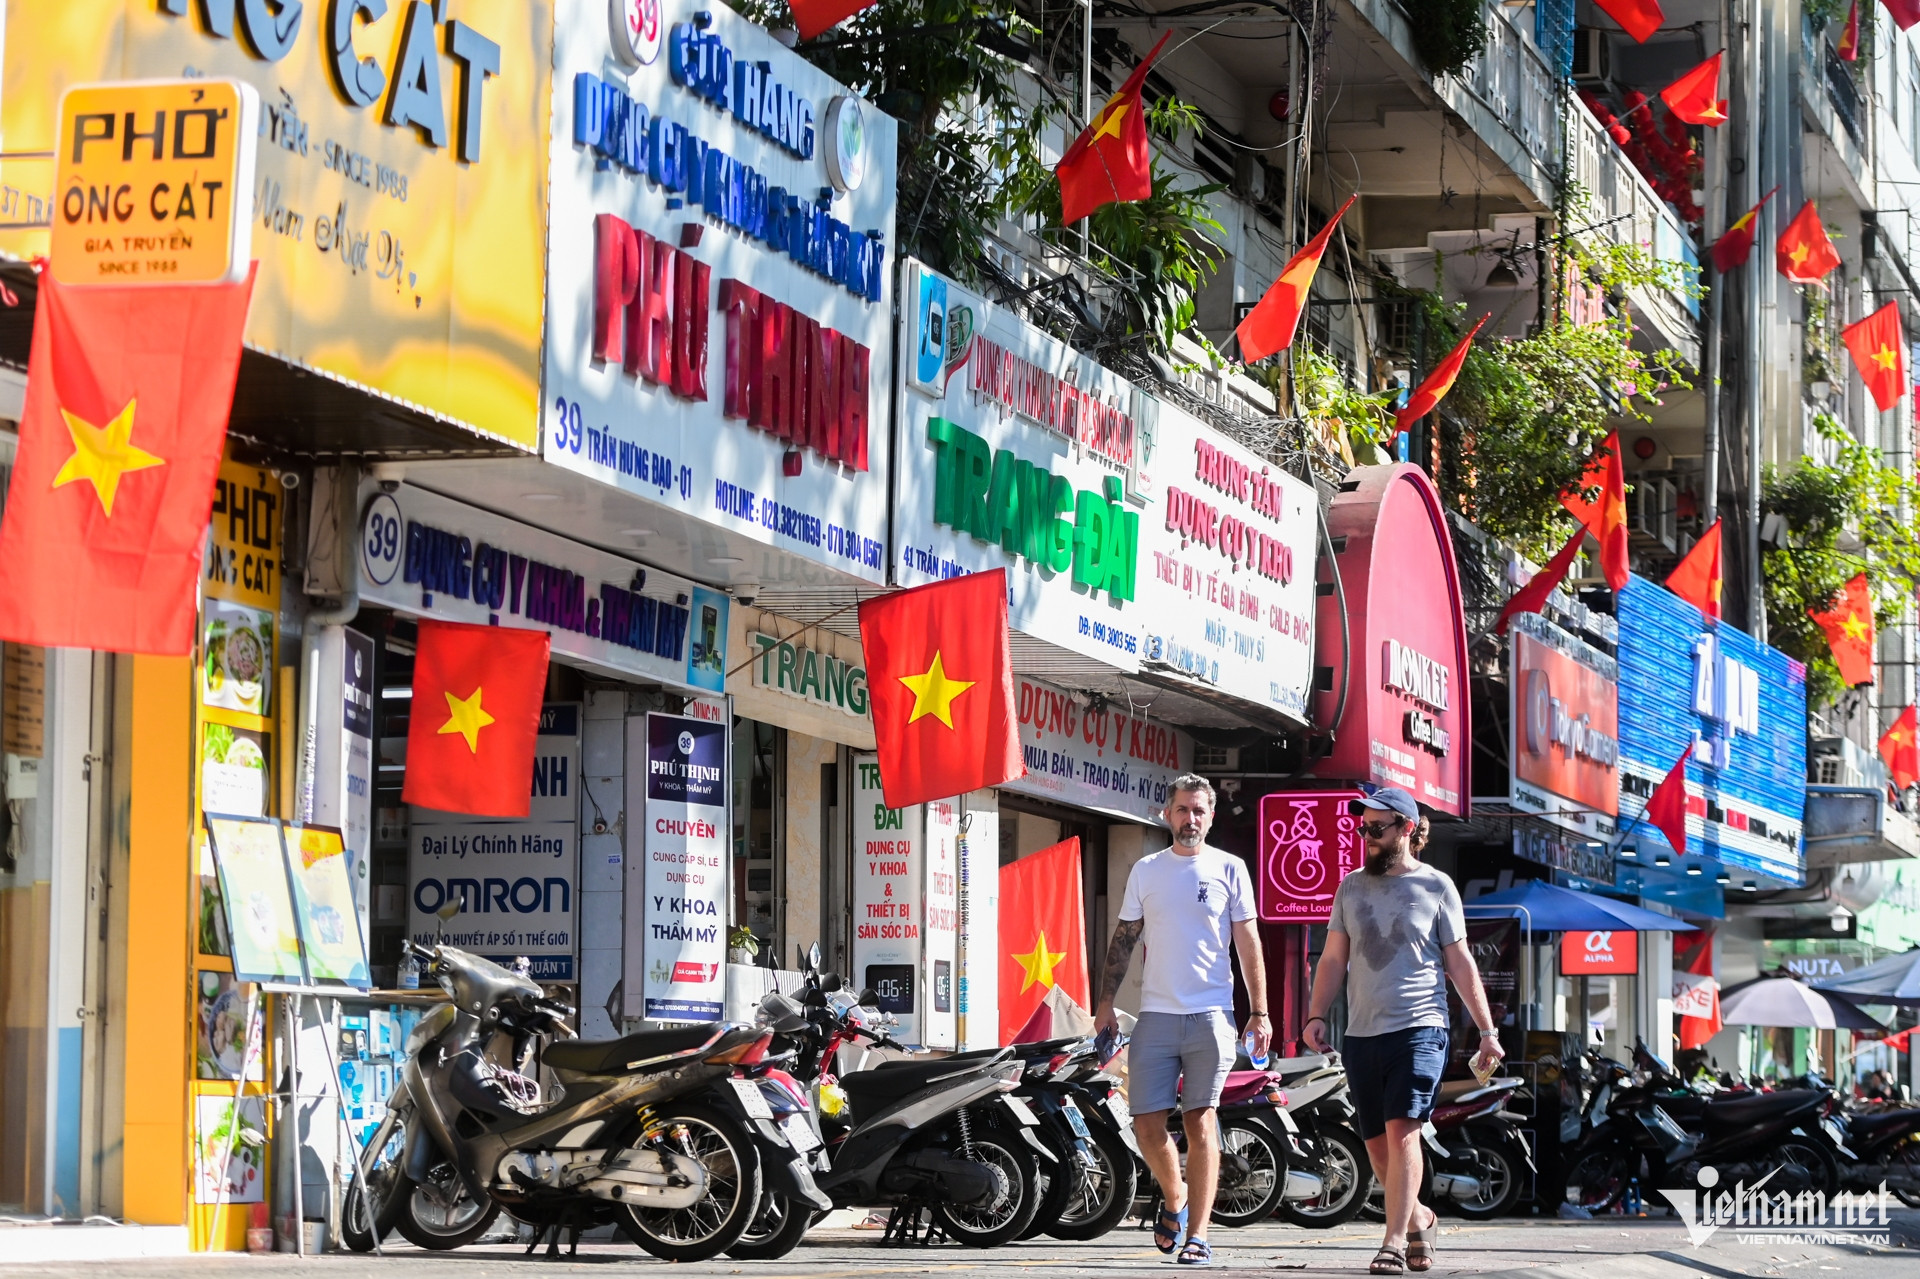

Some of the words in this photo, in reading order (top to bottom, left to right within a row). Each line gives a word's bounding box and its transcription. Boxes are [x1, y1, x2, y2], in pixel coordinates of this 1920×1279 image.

[72, 89, 228, 165] PHỞ
[257, 86, 309, 158] YỀN
[324, 138, 371, 188] SINCE
[375, 162, 409, 203] 1988
[63, 174, 135, 225] ÔNG
[150, 169, 223, 222] CÁT
[85, 238, 114, 253] GIA
[123, 227, 193, 253] TRUYỀN
[99, 261, 140, 275] SINCE
[145, 260, 178, 273] 1988
[592, 213, 711, 402] PHÚ
[718, 278, 870, 477] THỊNH
[555, 397, 582, 455] 39
[588, 424, 617, 466] TRẦN
[619, 440, 649, 482] HƯNG
[652, 459, 672, 497] ĐẠO
[680, 466, 692, 501] Q1
[1195, 438, 1249, 505] TRUNG
[1250, 465, 1283, 524] TÂM
[929, 417, 1075, 573] TRANG
[1073, 475, 1139, 603] ĐÀI
[368, 514, 399, 562] 39
[762, 497, 821, 548] 028.38211659
[828, 523, 844, 557] 070
[846, 529, 861, 563] 304
[864, 537, 883, 571] 0567
[1166, 486, 1219, 550] DỤNG
[1219, 513, 1245, 574] CỤ
[1246, 526, 1258, 570] Y
[903, 545, 914, 568] 41
[916, 544, 939, 579] TRẦN
[404, 521, 472, 608] DỤNG
[473, 543, 508, 626] CỤ
[510, 554, 527, 615] Y
[526, 560, 585, 634] KHOA
[586, 598, 601, 638] &
[657, 593, 689, 662] MỸ
[1183, 563, 1193, 600] BỊ
[1196, 569, 1202, 596] Y
[1270, 604, 1290, 636] CHLB
[1093, 621, 1106, 642] 090
[1107, 627, 1123, 649] 3003
[1142, 635, 1163, 660] 43
[747, 631, 867, 717] TRANG
[1019, 682, 1076, 739] DỤNG
[1083, 706, 1109, 757] CỤ
[1114, 713, 1126, 753] Y
[1129, 718, 1179, 770] KHOA
[680, 737, 692, 749] 39
[531, 756, 568, 797] NH
[651, 758, 677, 777] PHÚ
[679, 764, 720, 783] THỊNH
[859, 763, 883, 789] TR
[1024, 745, 1047, 772] MUA
[1051, 749, 1074, 779] BÁN
[1083, 761, 1109, 788] TRAO
[1112, 762, 1129, 794] ĐỔI
[1139, 774, 1152, 800] KÝ
[1154, 775, 1168, 805] GỞ
[659, 781, 664, 789] Y
[664, 782, 681, 791] KHOA
[655, 818, 716, 839] CHUYÊN
[421, 836, 448, 860] Đại
[452, 835, 469, 859] Lý
[472, 835, 517, 854] Chính
[522, 835, 563, 857] Hãng
[653, 851, 677, 863] CUNG
[678, 851, 696, 865] CẤP
[866, 841, 895, 858] DỤNG
[897, 841, 911, 858] CỤ
[667, 872, 690, 884] DỤNG
[692, 873, 705, 885] CỤ
[870, 862, 877, 876] Y
[879, 862, 908, 876] KHOA
[884, 882, 893, 897] &
[654, 896, 664, 911] Y
[670, 897, 717, 916] KHOA
[866, 898, 896, 918] THIẾT
[899, 904, 910, 921] BỊ
[1275, 903, 1308, 913] Coffee
[413, 929, 434, 946] MÁY
[453, 930, 485, 946] HUYẾT
[487, 930, 501, 946] ÁP
[502, 929, 516, 946] SỐ
[518, 933, 523, 945] 1
[526, 929, 547, 946] THẾ
[548, 931, 569, 946] GIỚI
[652, 920, 692, 942] THẨM
[696, 925, 717, 943] MỸ
[858, 922, 878, 939] SĂN
[881, 921, 902, 939] SÓC
[904, 925, 919, 938] DA
[1584, 954, 1614, 963] ALPHA
[1788, 959, 1845, 976] NUTA
[878, 979, 899, 997] 106
